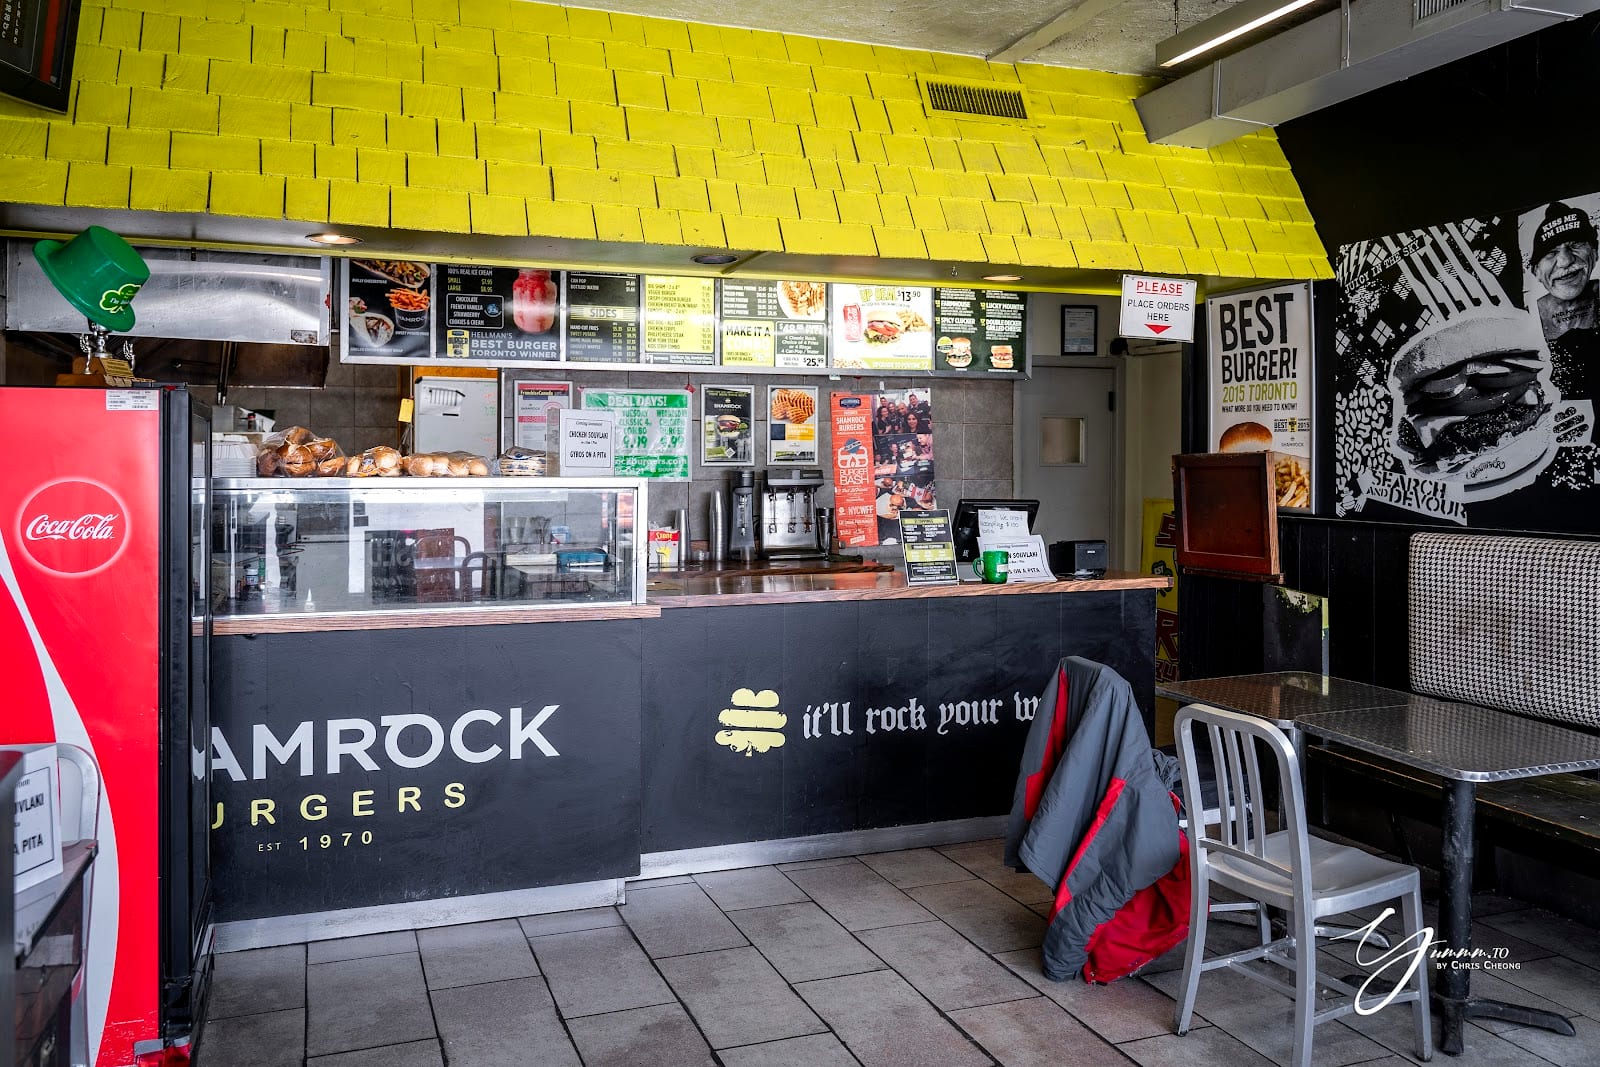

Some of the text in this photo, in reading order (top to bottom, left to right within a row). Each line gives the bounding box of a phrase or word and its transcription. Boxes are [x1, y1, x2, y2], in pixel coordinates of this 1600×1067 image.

[1541, 221, 1580, 242] I'M IRISH
[1542, 214, 1577, 233] KISS ME
[1344, 240, 1420, 294] JUICY IN THE SKY
[897, 290, 921, 302] $13.90
[1136, 281, 1183, 294] PLEASE
[590, 309, 617, 318] SIDES
[1128, 299, 1190, 311] PLACE ORDERS
[1147, 312, 1169, 321] HERE
[1220, 292, 1294, 352] BEST
[726, 325, 752, 336] MAKE
[754, 327, 762, 336] IT
[764, 327, 771, 337] A
[471, 340, 557, 350] BEST BURGER
[471, 349, 516, 357] TORONTO
[804, 357, 824, 367] $25.99
[1222, 348, 1297, 384] BURGER!
[608, 396, 667, 406] DEAL DAYS!
[1222, 382, 1297, 403] 2015 TORONTO
[1262, 404, 1272, 412] NEED
[836, 416, 866, 424] SHAMROCK
[840, 475, 869, 485] BASH
[1372, 470, 1446, 498] SEARCH
[1367, 487, 1466, 518] AND DEVOUR
[26, 514, 119, 540] Coca-Cola
[802, 702, 854, 740] it'll
[865, 697, 928, 734] rock
[937, 698, 1004, 735] your
[210, 704, 560, 782] AMROCK
[212, 782, 466, 830] URGERS
[22, 834, 44, 853] PITA
[258, 830, 373, 852] EST 1970
